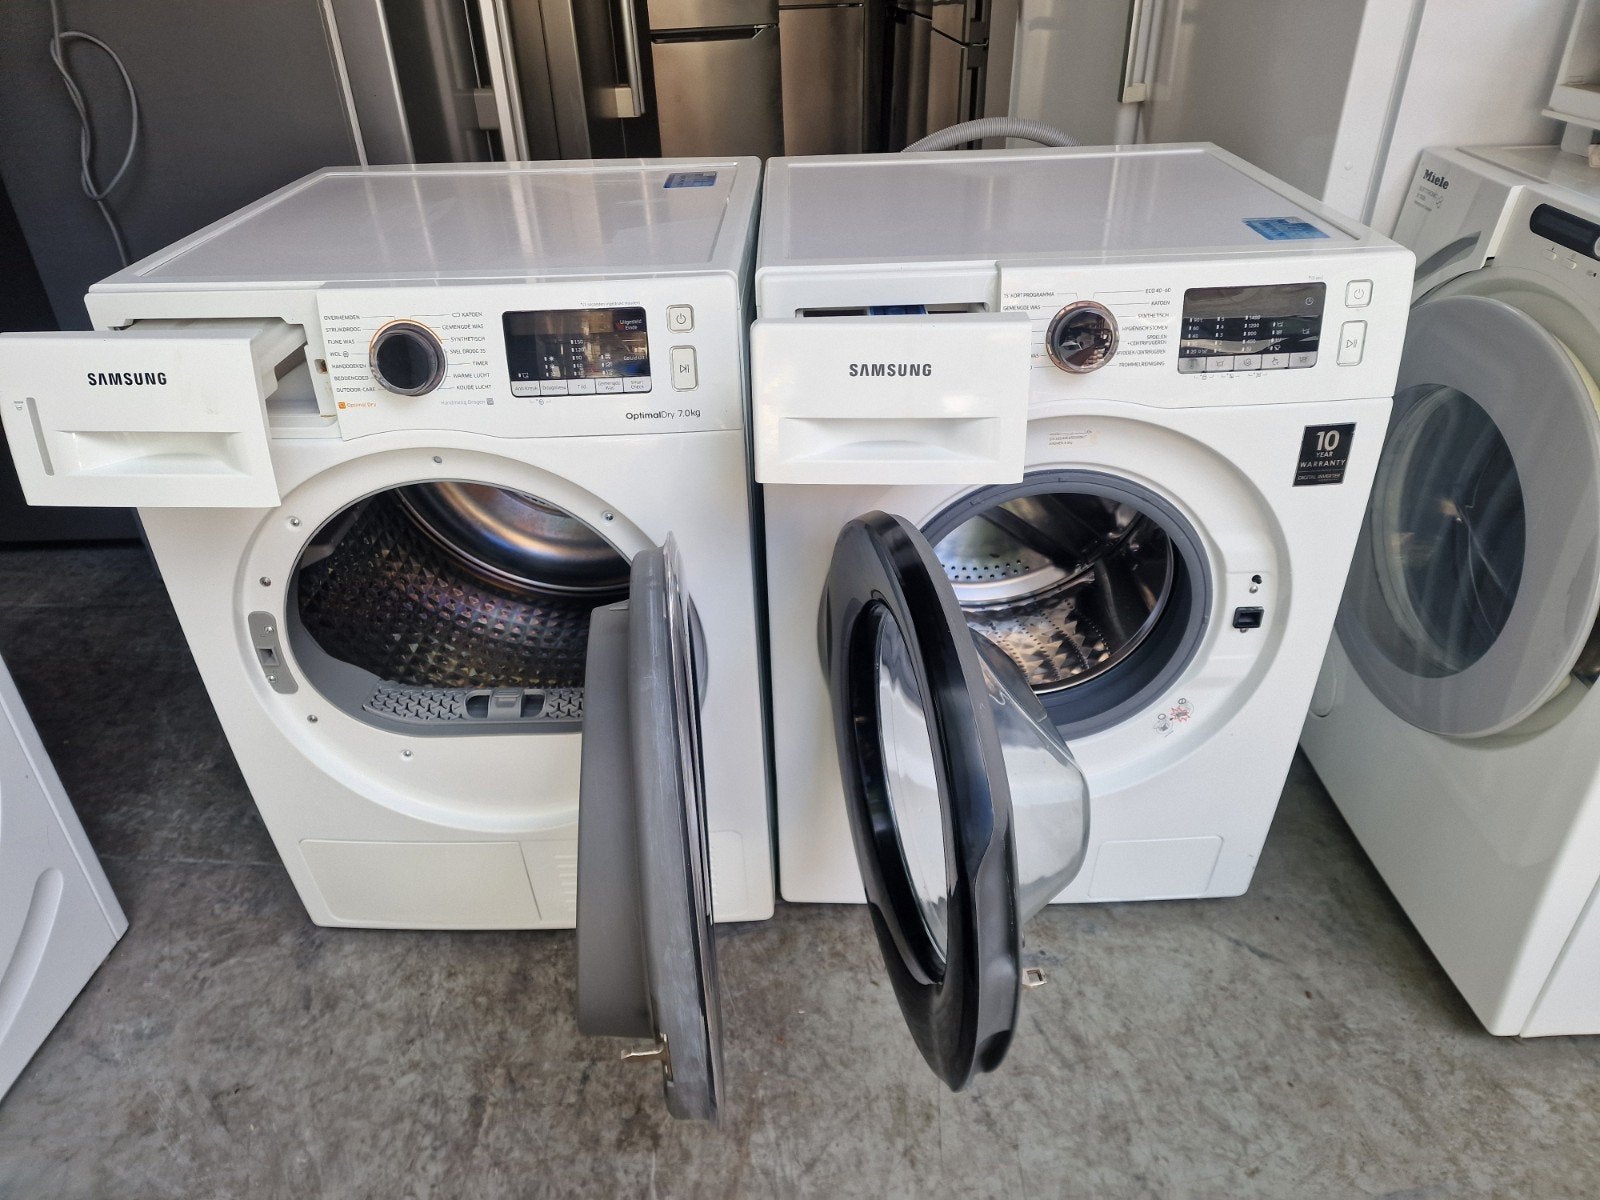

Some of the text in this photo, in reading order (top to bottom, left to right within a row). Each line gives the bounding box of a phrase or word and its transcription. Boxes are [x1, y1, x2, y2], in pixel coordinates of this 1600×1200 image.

[1422, 168, 1449, 190] Miele
[849, 363, 932, 377] SAMSUNG
[87, 372, 167, 386] SAMSUNG
[677, 409, 701, 418] 7.0kg
[1316, 430, 1340, 451] 10
[1300, 460, 1346, 468] WARRANTY
